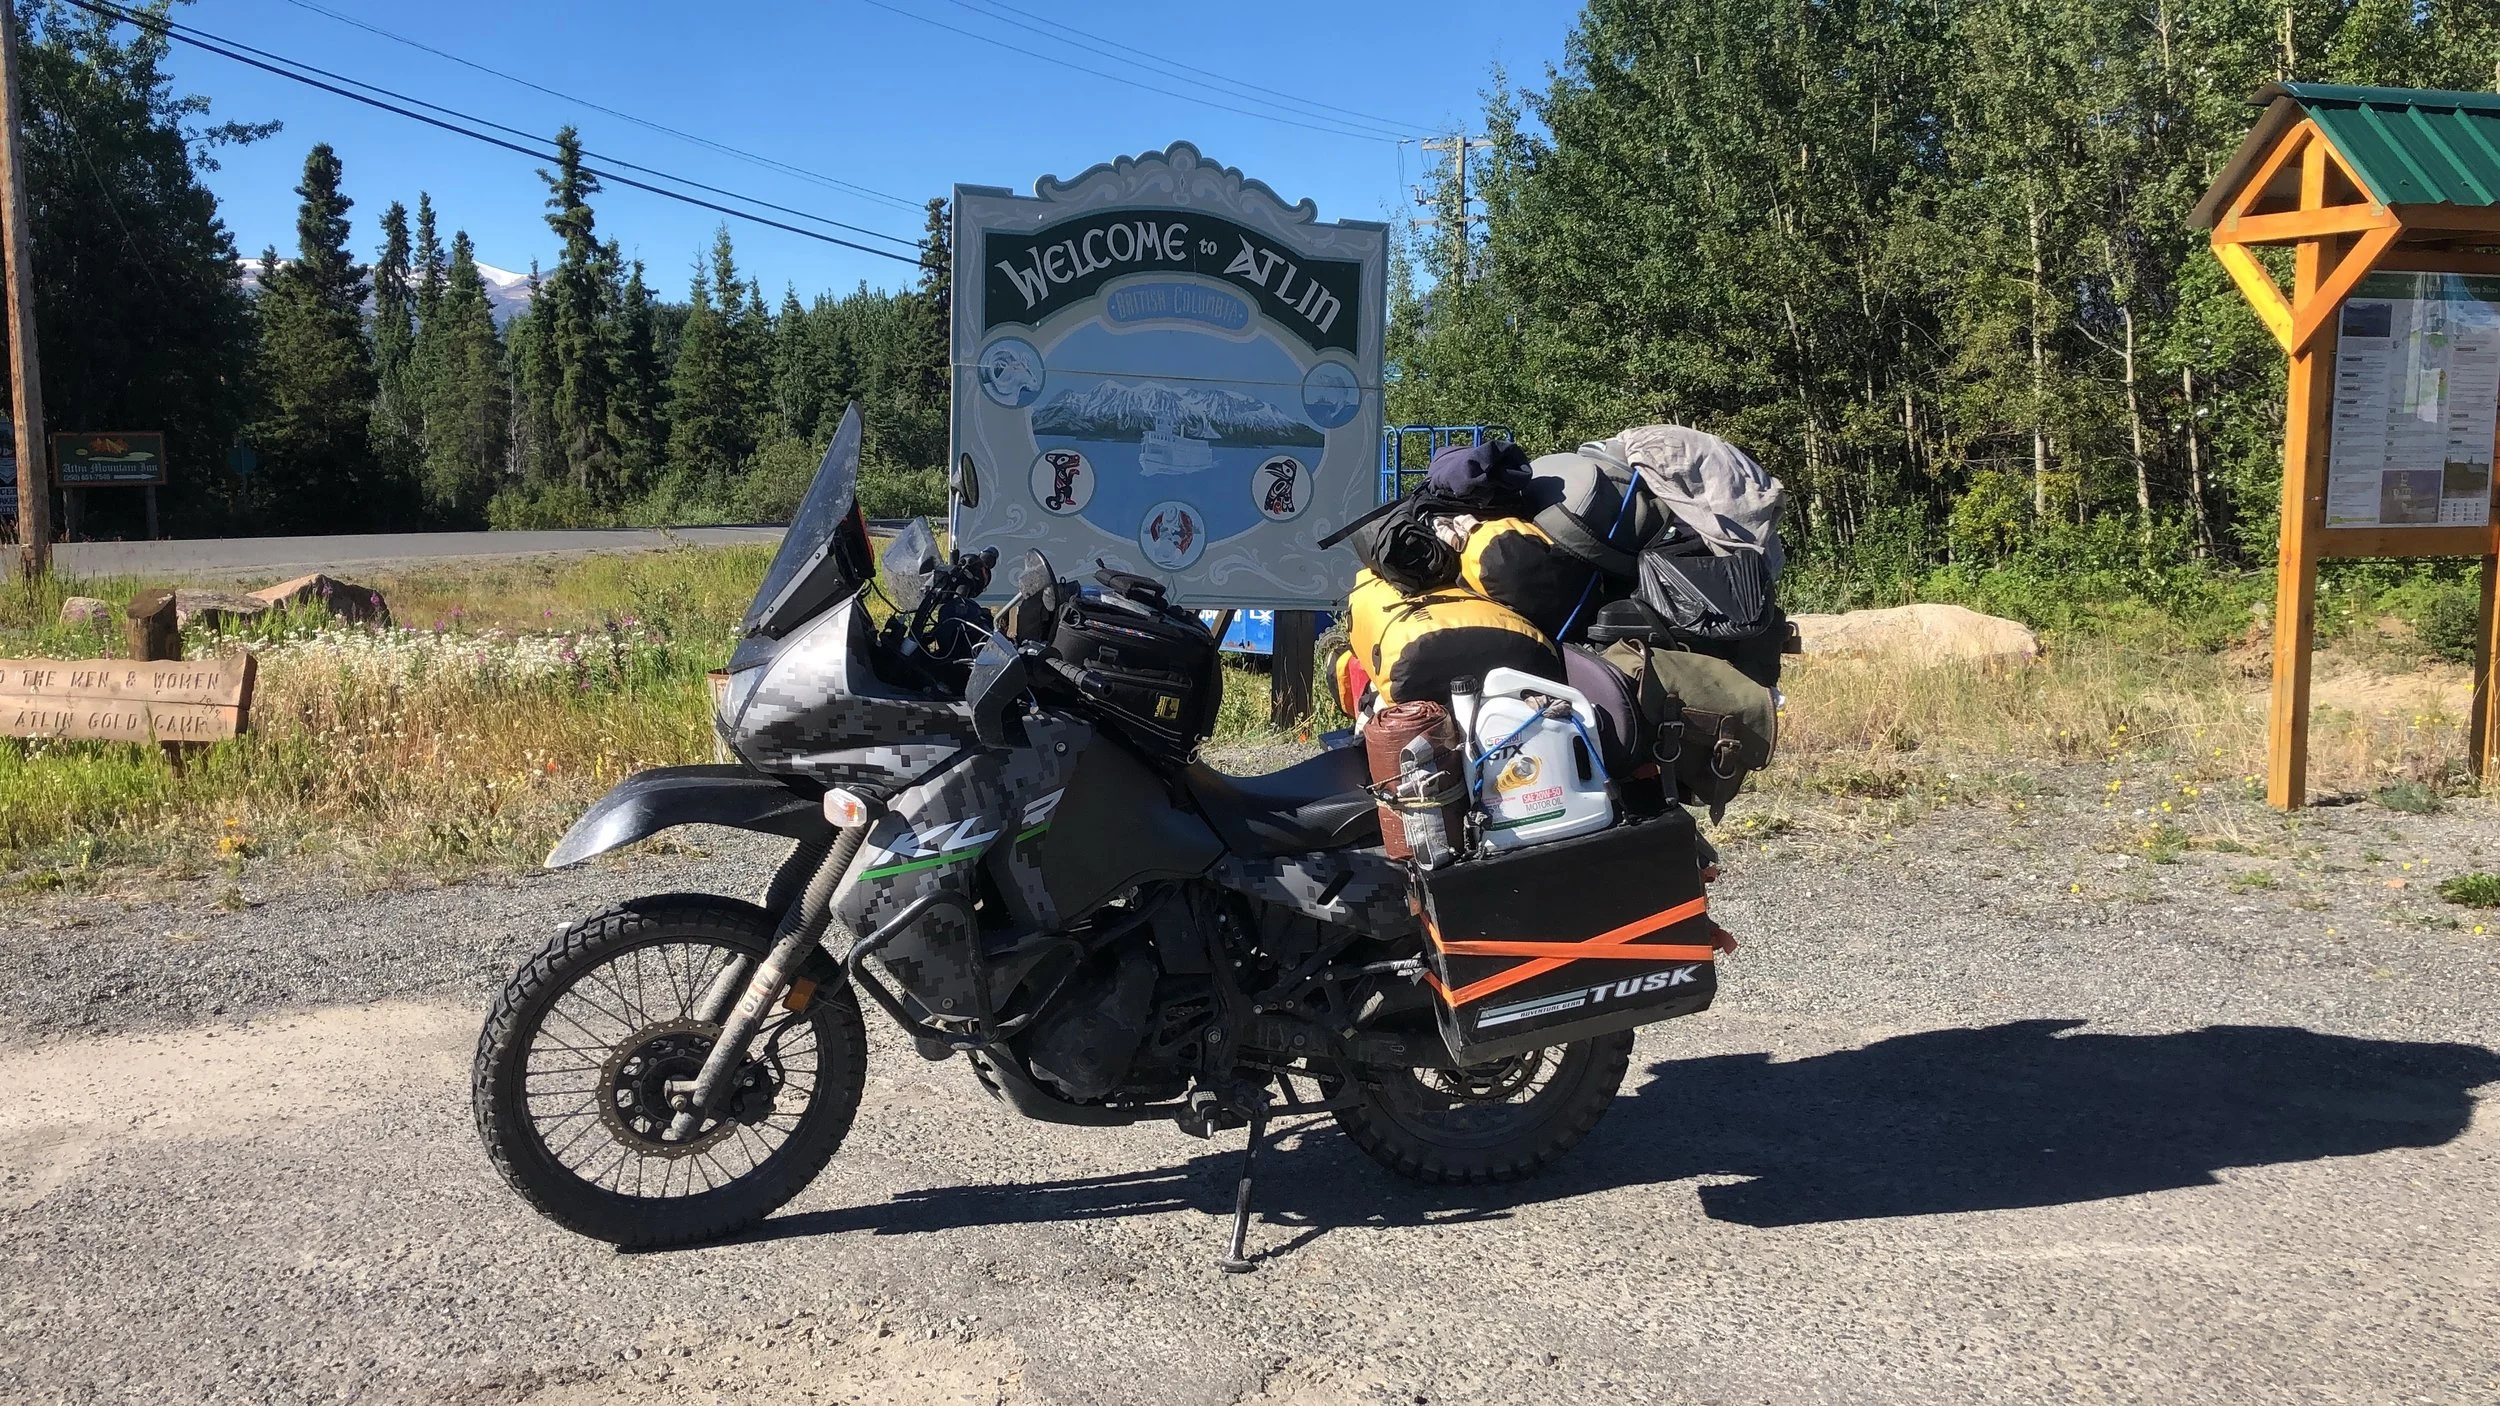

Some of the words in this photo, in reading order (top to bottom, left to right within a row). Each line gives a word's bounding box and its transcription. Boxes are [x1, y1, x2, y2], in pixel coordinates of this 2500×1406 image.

[994, 221, 1189, 310] WELCOME
[1199, 238, 1217, 255] to
[1223, 234, 1341, 334] ATLIN
[1115, 288, 1167, 319] BRITISH
[63, 463, 87, 473] Atlin
[90, 463, 137, 473] Mountain
[140, 462, 158, 472] Inn
[23, 670, 57, 687] THE
[71, 671, 110, 688] MEN
[126, 671, 136, 688] &
[154, 672, 219, 690] WOMEN
[15, 711, 73, 729] ATLIN
[88, 712, 137, 730] GOLD
[154, 714, 208, 733] CAMP
[1487, 743, 1524, 761] GTX
[1522, 794, 1535, 803] SAE
[1535, 787, 1562, 800] 20W-50
[1525, 799, 1551, 812] MOTOR
[1552, 798, 1564, 807] OIL
[1590, 964, 1702, 1004] TUSK
[1520, 1006, 1560, 1018] ADVENTURE
[1562, 1000, 1581, 1009] GEAR
